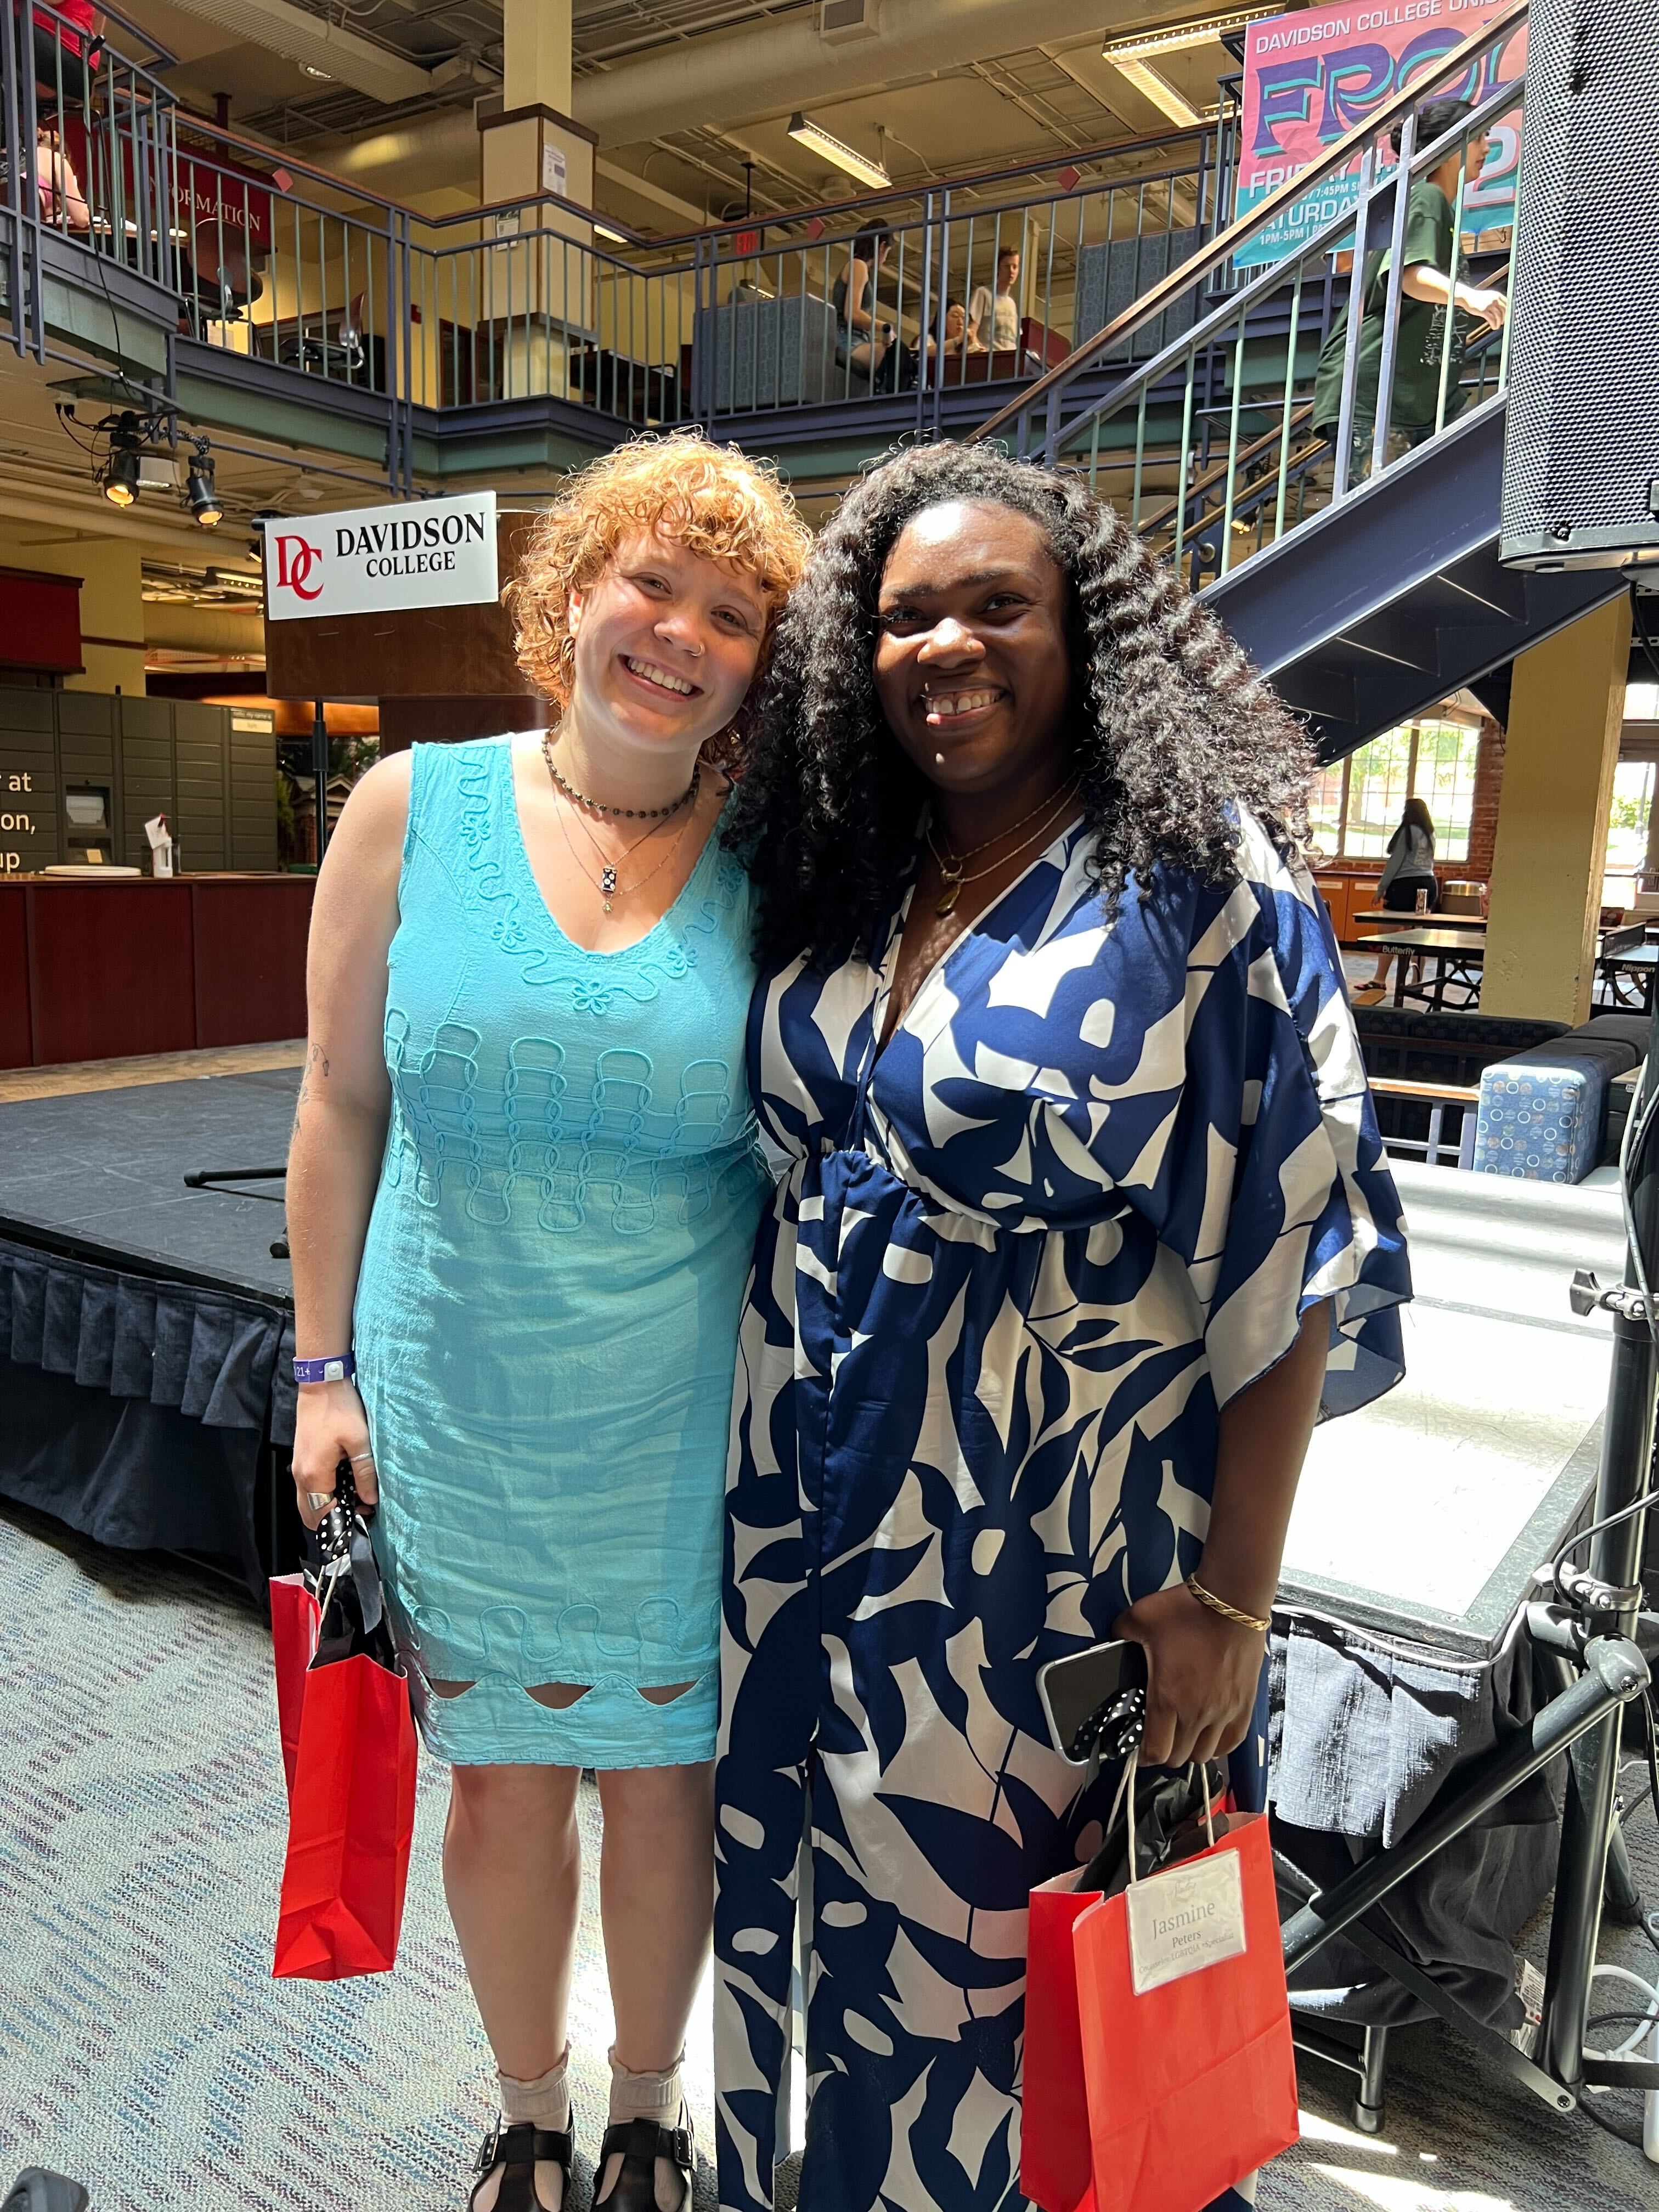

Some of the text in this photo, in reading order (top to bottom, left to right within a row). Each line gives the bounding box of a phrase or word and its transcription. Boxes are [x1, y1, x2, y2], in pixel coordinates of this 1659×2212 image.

[1256, 18, 1351, 54] DAVIDSON
[1357, 0, 1443, 32] COLLEGE
[1260, 227, 1304, 245] 1PM-5PM
[335, 512, 486, 558] DAVIDSON
[274, 535, 324, 601] DC
[365, 550, 456, 578] COLLEGE
[9, 772, 32, 792] at
[1382, 945, 1415, 955] Butterfly
[1621, 963, 1655, 973] Nippon
[1153, 1901, 1216, 1940] Jasmine
[1172, 1931, 1201, 1948] Peters
